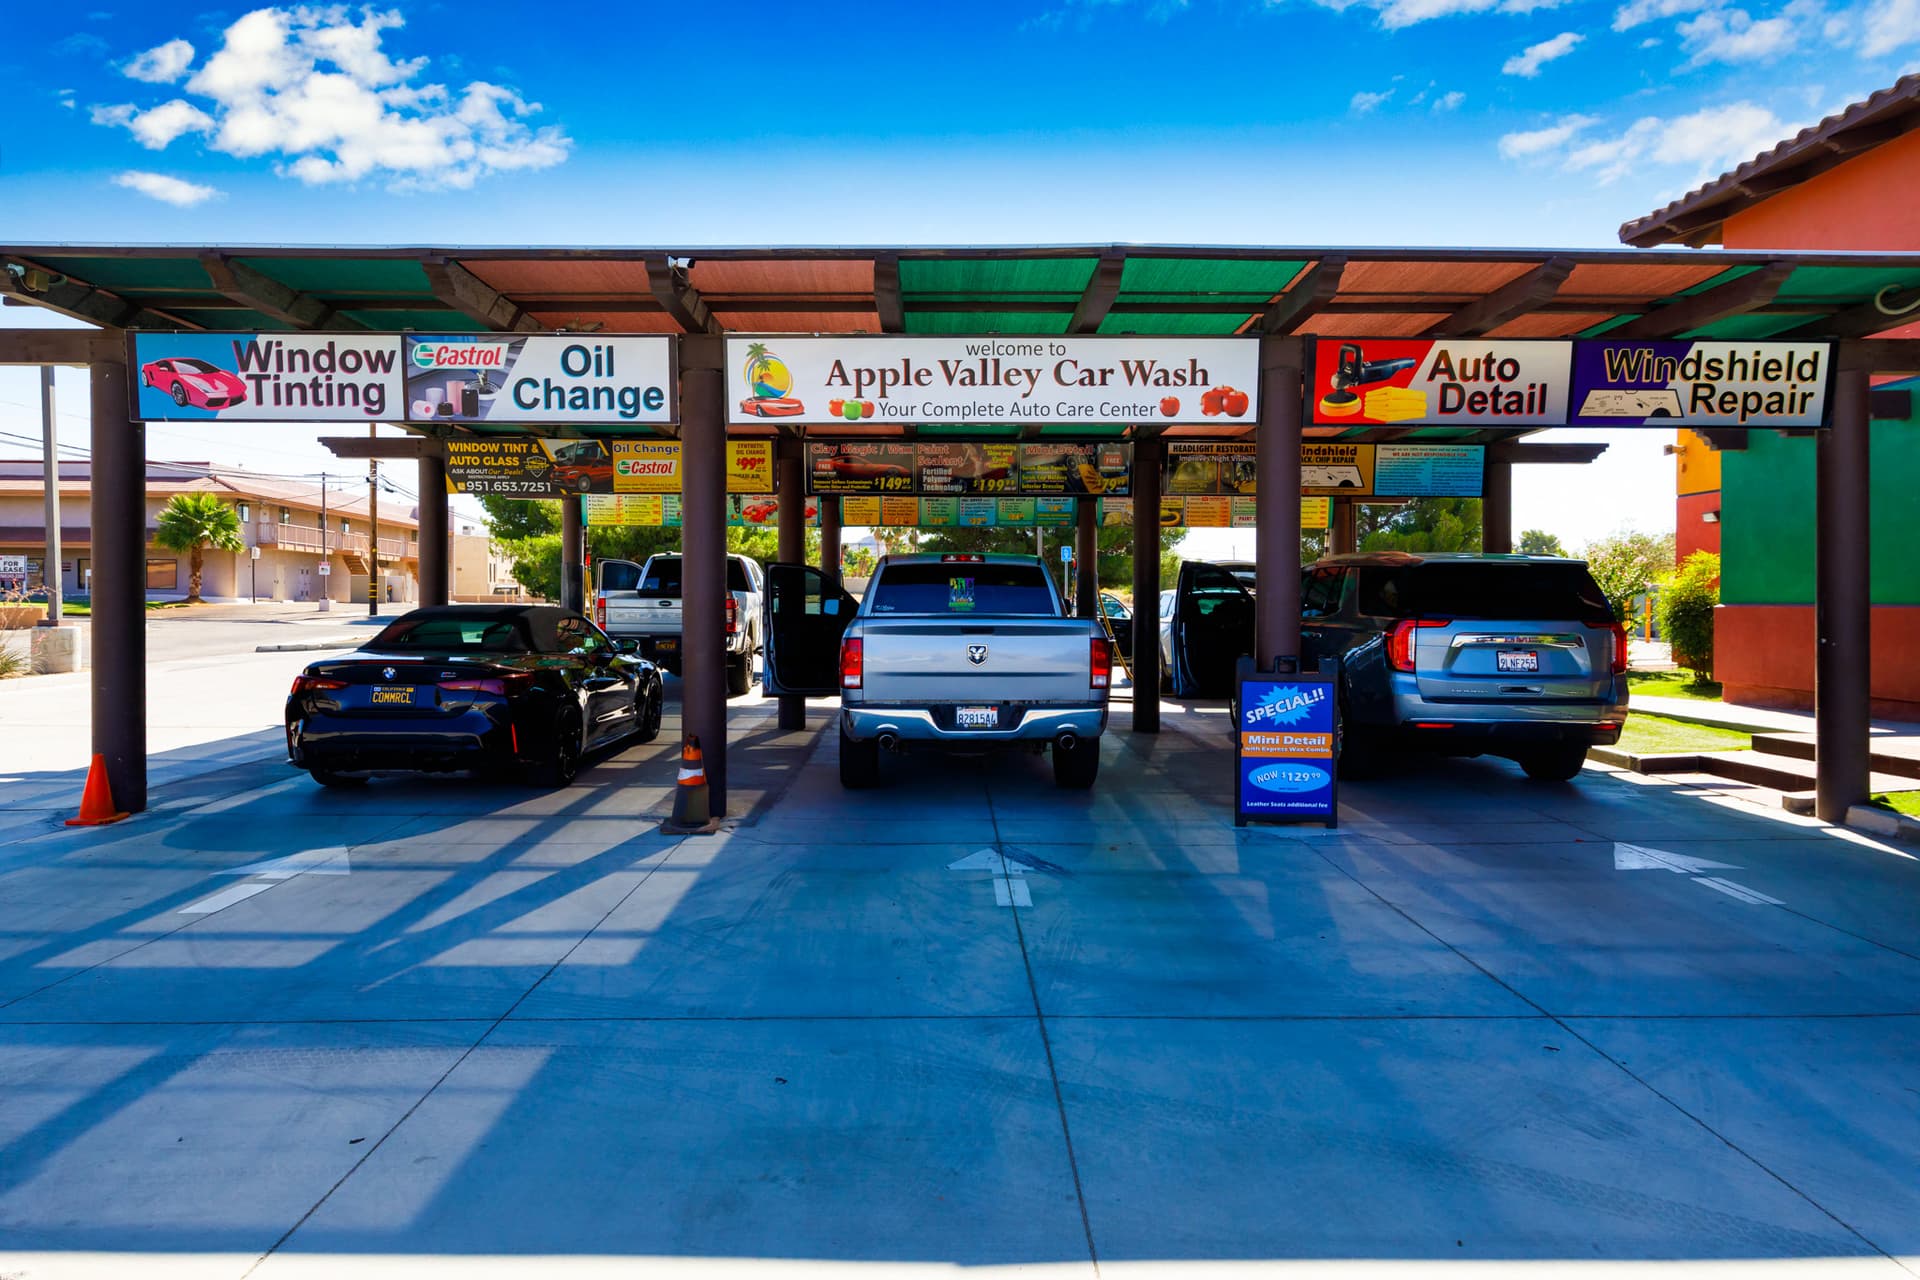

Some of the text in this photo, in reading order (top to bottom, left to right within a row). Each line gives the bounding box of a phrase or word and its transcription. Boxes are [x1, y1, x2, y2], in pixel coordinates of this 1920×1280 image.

[435, 345, 502, 366] Castrol
[965, 341, 1066, 357] welcome to
[231, 340, 396, 374] Window
[560, 344, 615, 378] Oil
[1426, 349, 1521, 384] Auto
[1603, 347, 1820, 385] Windshield
[825, 358, 1210, 399] Apple Valley Car Wash
[246, 374, 388, 415] Tinting
[512, 377, 665, 418] Change
[1438, 382, 1548, 416] Detail
[1688, 384, 1815, 423] Repair
[879, 401, 1157, 421] Your Complete Auto Care Center
[448, 443, 539, 453] WINDOW TINT &
[613, 444, 680, 455] Oil Change
[810, 443, 838, 456] Clay
[841, 443, 878, 456] Magic
[917, 443, 950, 454] Paint
[1173, 444, 1256, 453] HEADLIGHT RESTORATI
[1301, 446, 1358, 455] indshield
[449, 456, 520, 466] AUTO GLASS
[631, 461, 673, 474] Castrol
[917, 455, 965, 466] Sealant
[466, 481, 551, 492] 951.653.7251
[1500, 658, 1536, 669] 9LNF255
[372, 691, 412, 704] COMMRCL
[1246, 688, 1325, 724] SPECIAL!!
[1248, 736, 1326, 745] Mini Detail
[1256, 770, 1279, 784] NOW
